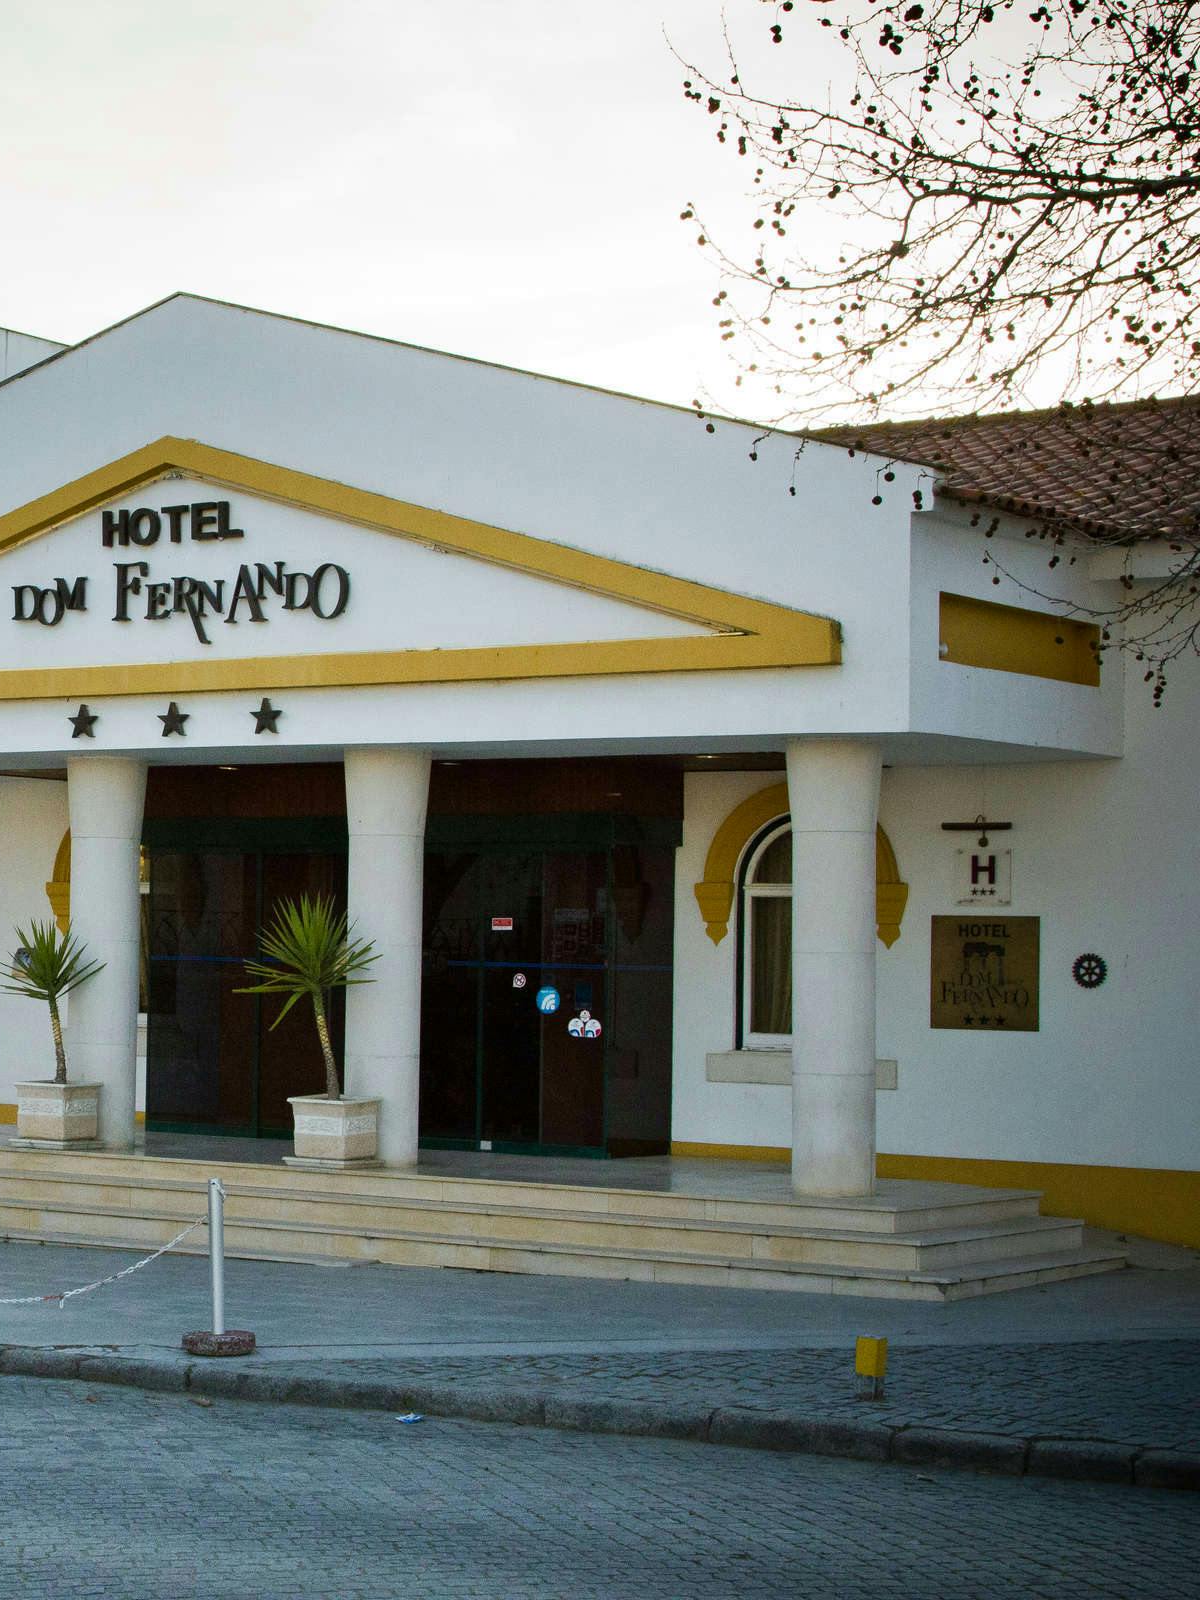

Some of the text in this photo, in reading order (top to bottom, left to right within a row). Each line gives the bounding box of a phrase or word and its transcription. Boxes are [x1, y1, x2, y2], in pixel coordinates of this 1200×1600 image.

[102, 501, 244, 547] HOTEL
[11, 561, 350, 645] DOM FERNANDO
[971, 855, 996, 884] H
[958, 924, 1011, 938] HOTEL
